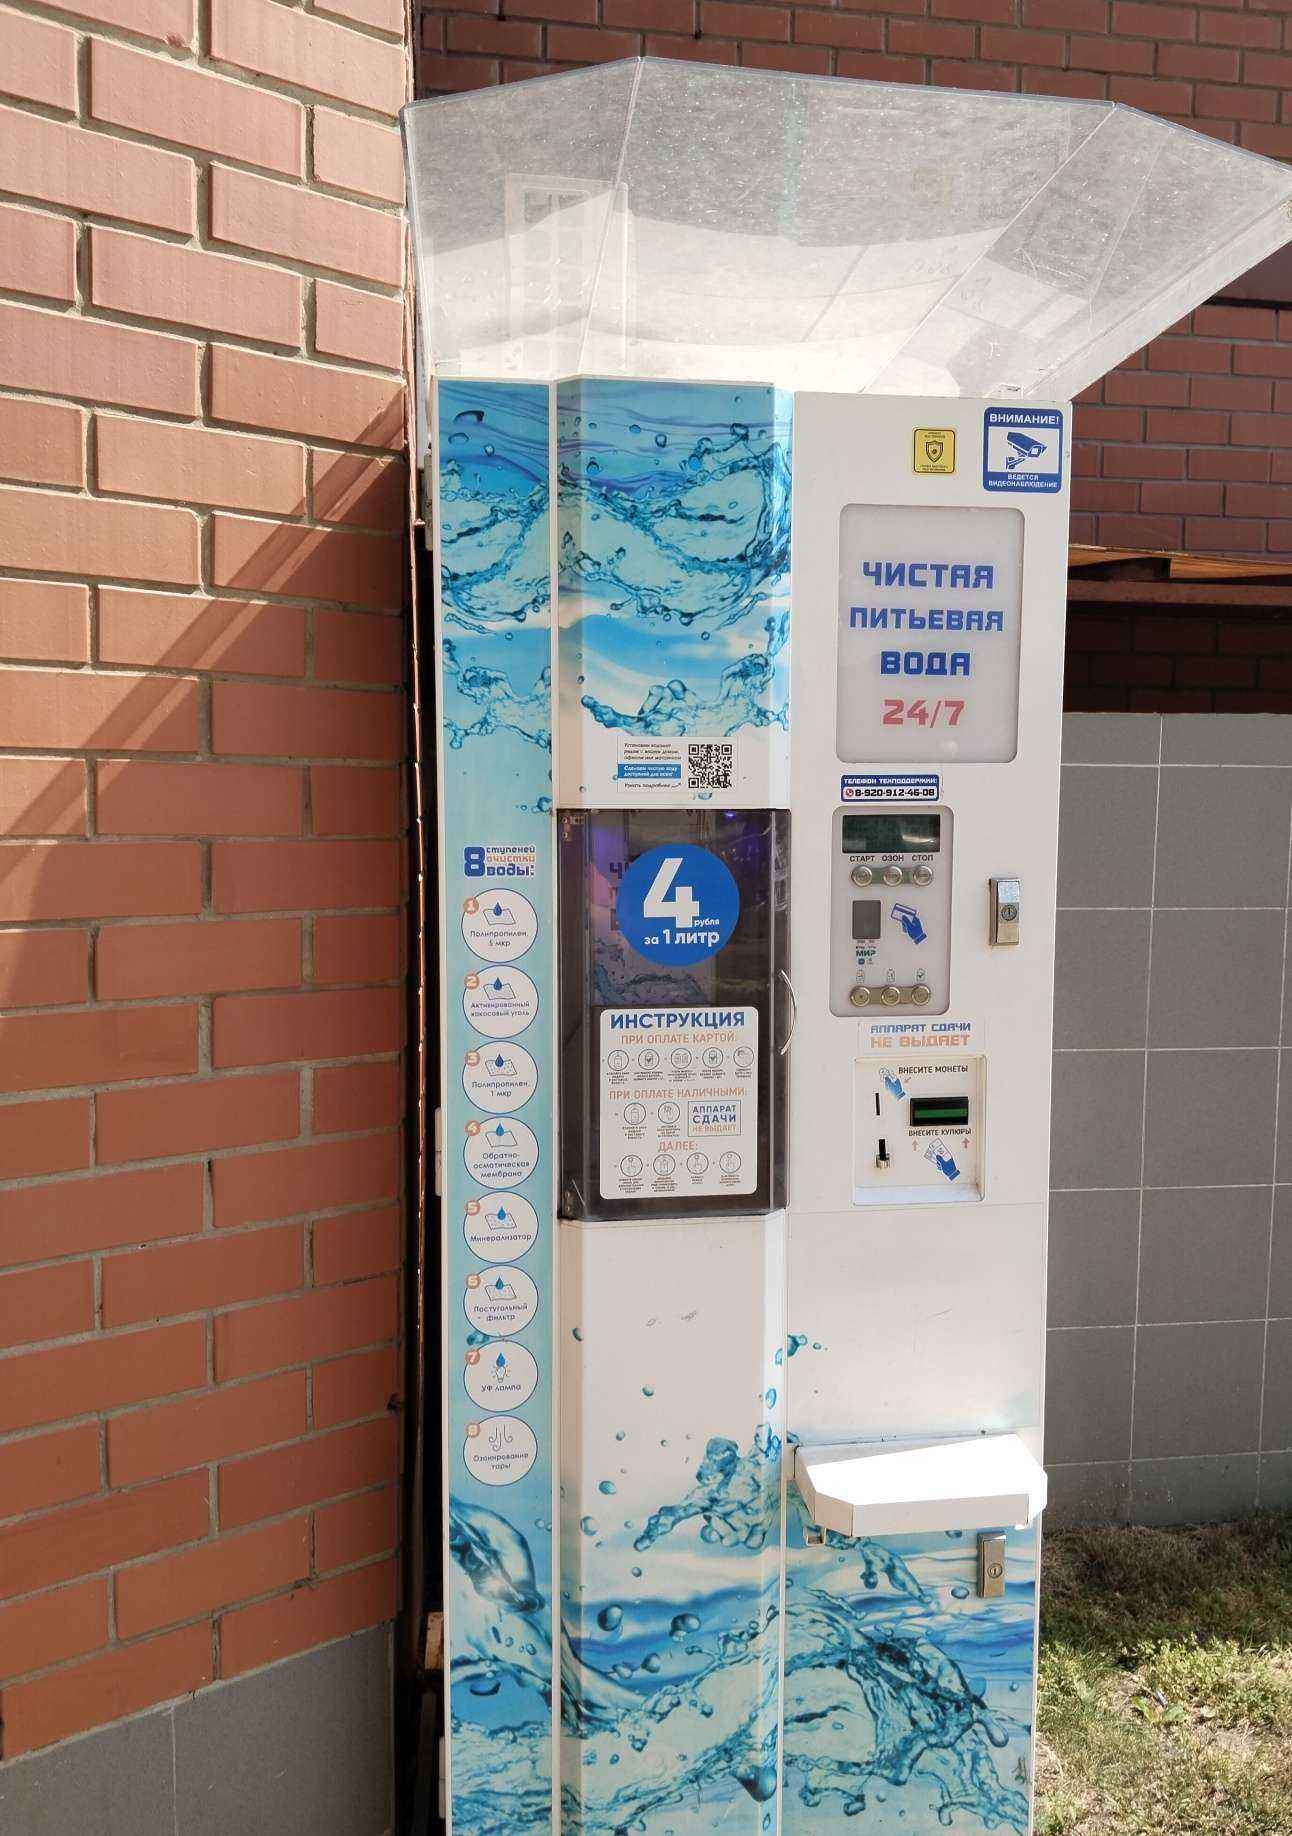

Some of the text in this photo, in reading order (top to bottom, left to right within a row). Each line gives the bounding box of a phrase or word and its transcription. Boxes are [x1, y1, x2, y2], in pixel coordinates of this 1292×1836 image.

[989, 413, 1060, 425] ВНИМАНИЕ!
[988, 480, 1058, 488] ВИДЕОНАБЛЮДЕНИЕ
[863, 562, 994, 589] ЧИСТАЯ
[850, 607, 1004, 631] ПИТЬЕВАЯ
[880, 651, 971, 676] ВОДА
[883, 700, 965, 728] 24/7
[855, 789, 935, 797] 8-920-912-46-08
[486, 846, 536, 855] ступеней
[464, 847, 485, 877] 8
[487, 854, 535, 863] очистки
[487, 864, 534, 876] воды:
[644, 857, 700, 928] 4
[694, 918, 720, 927] рубля
[644, 929, 720, 947] за 1 литр
[471, 1001, 530, 1010] Активированный
[611, 1012, 745, 1029] ИНСТРУКЦИЯ
[871, 1023, 971, 1033] АППАРАТ СДАЧИ
[622, 1035, 644, 1045] ПРИ
[647, 1034, 689, 1044] ОПЛАТЕ
[871, 1035, 971, 1049] НЕ ВЫДАЕТ
[898, 1065, 968, 1074] ВНЕСИТЕ МОНЕТЫ
[609, 1090, 630, 1100] ПРИ
[634, 1089, 674, 1099] ОПЛАТЕ
[692, 1104, 737, 1113] АППАРАТ
[692, 1114, 736, 1124] СДАЧИ
[658, 1140, 698, 1152] ДАЛЕЕ:
[470, 1234, 532, 1243] Минерализатор
[486, 1314, 516, 1322] фильтр
[495, 1384, 522, 1392] лампа
[473, 1453, 529, 1462] Озонирование
